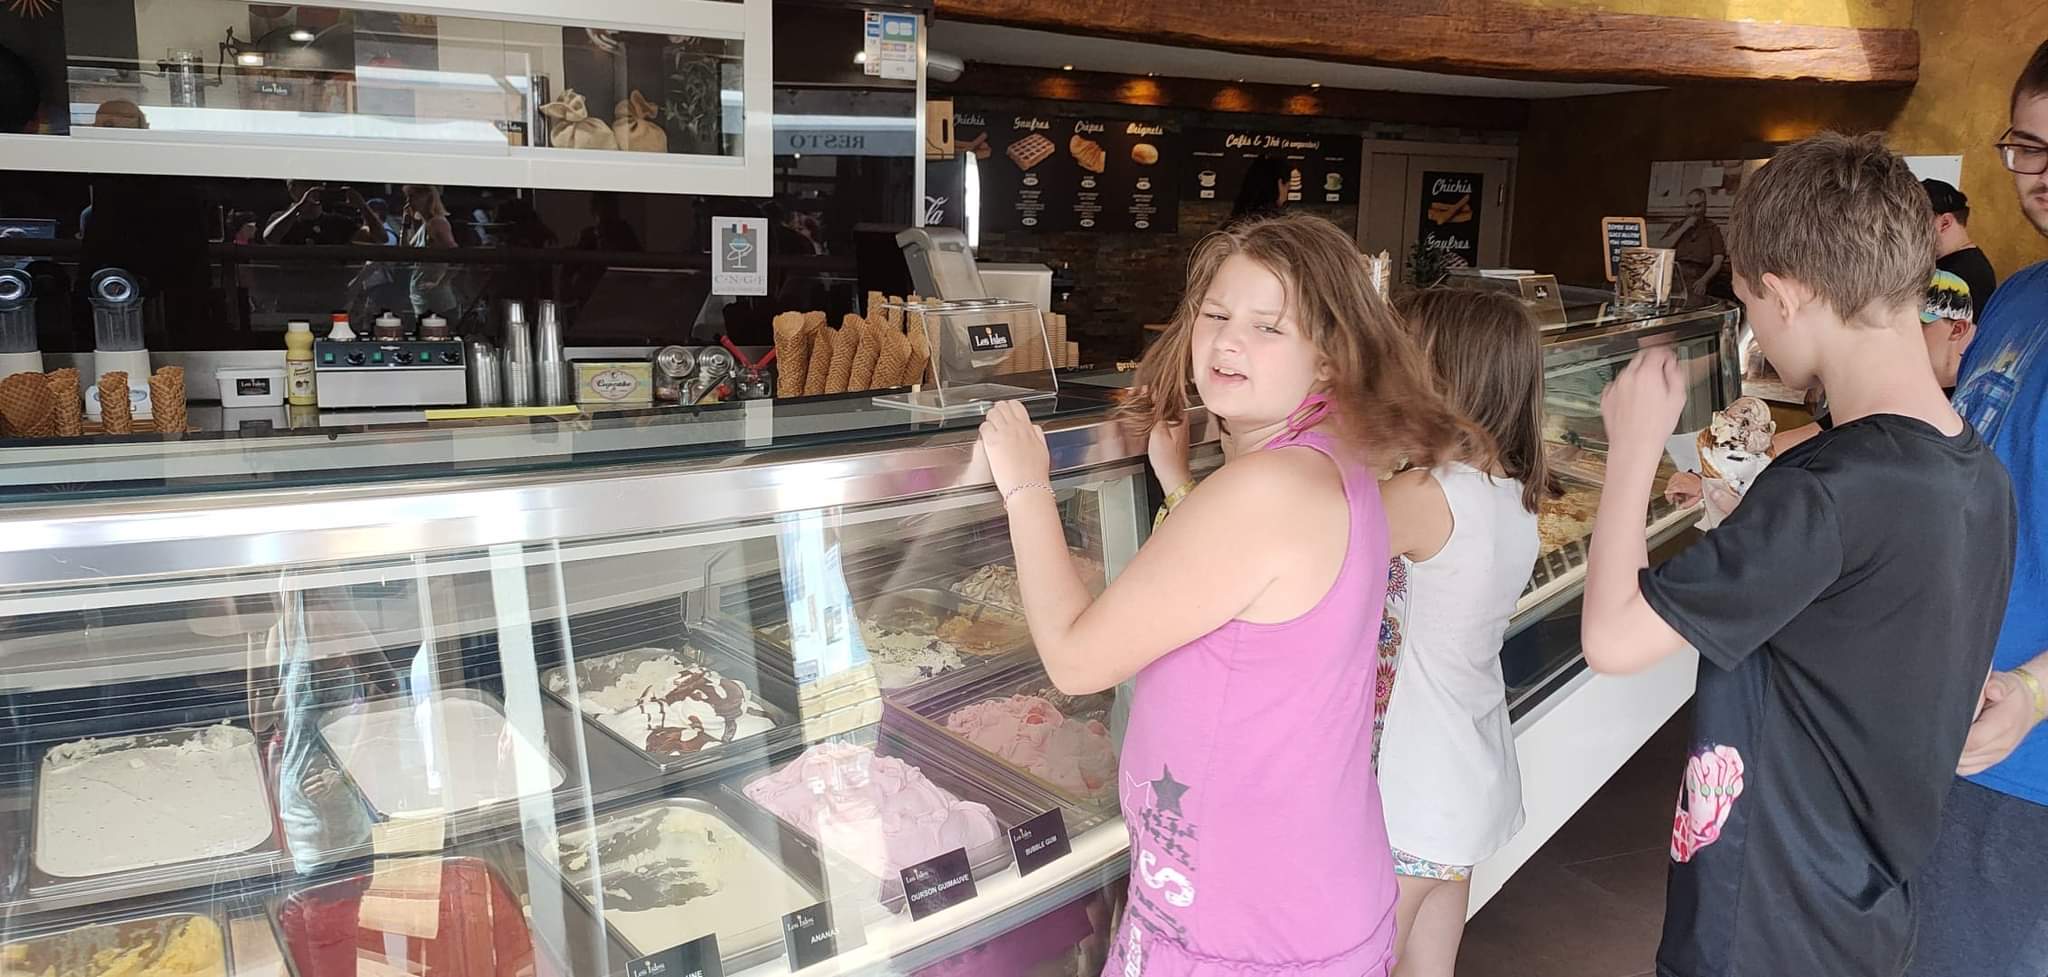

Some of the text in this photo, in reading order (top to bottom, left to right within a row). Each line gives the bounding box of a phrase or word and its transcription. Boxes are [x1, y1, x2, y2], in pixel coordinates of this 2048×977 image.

[1013, 117, 1050, 131] Gaufres
[1432, 178, 1473, 196] Chichis
[911, 873, 970, 902] OURSON GUIMAUVE
